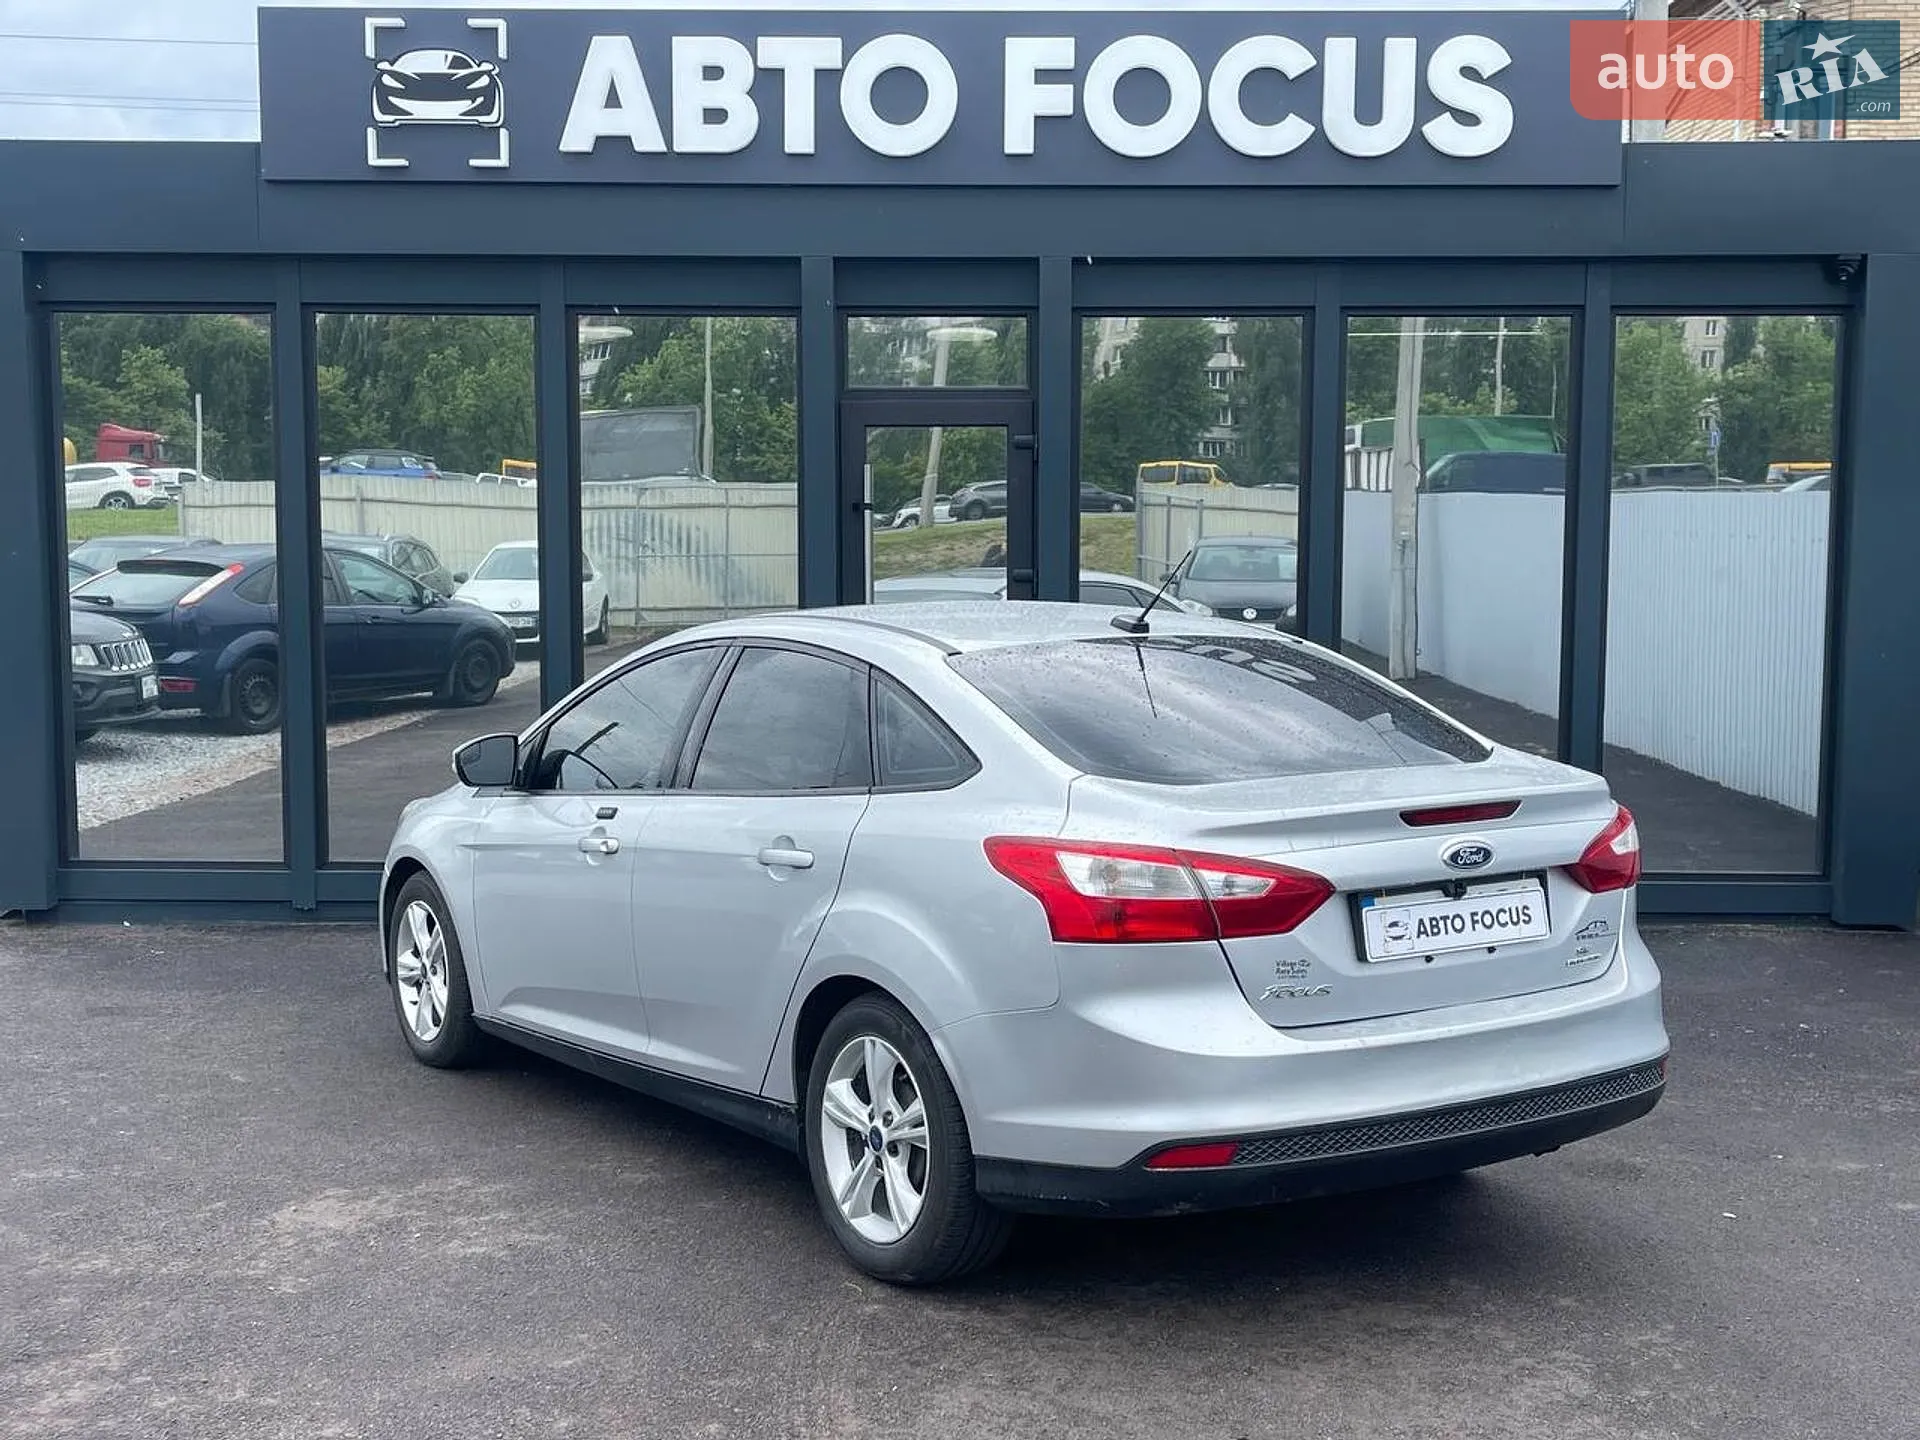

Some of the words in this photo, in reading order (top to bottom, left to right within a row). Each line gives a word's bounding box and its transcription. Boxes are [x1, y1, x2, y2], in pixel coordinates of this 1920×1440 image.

[559, 34, 958, 156] АВТО
[1003, 35, 1515, 158] FOCUS
[1457, 847, 1484, 864] Ford
[1416, 913, 1465, 939] АВТО
[1471, 905, 1533, 931] FOCUS
